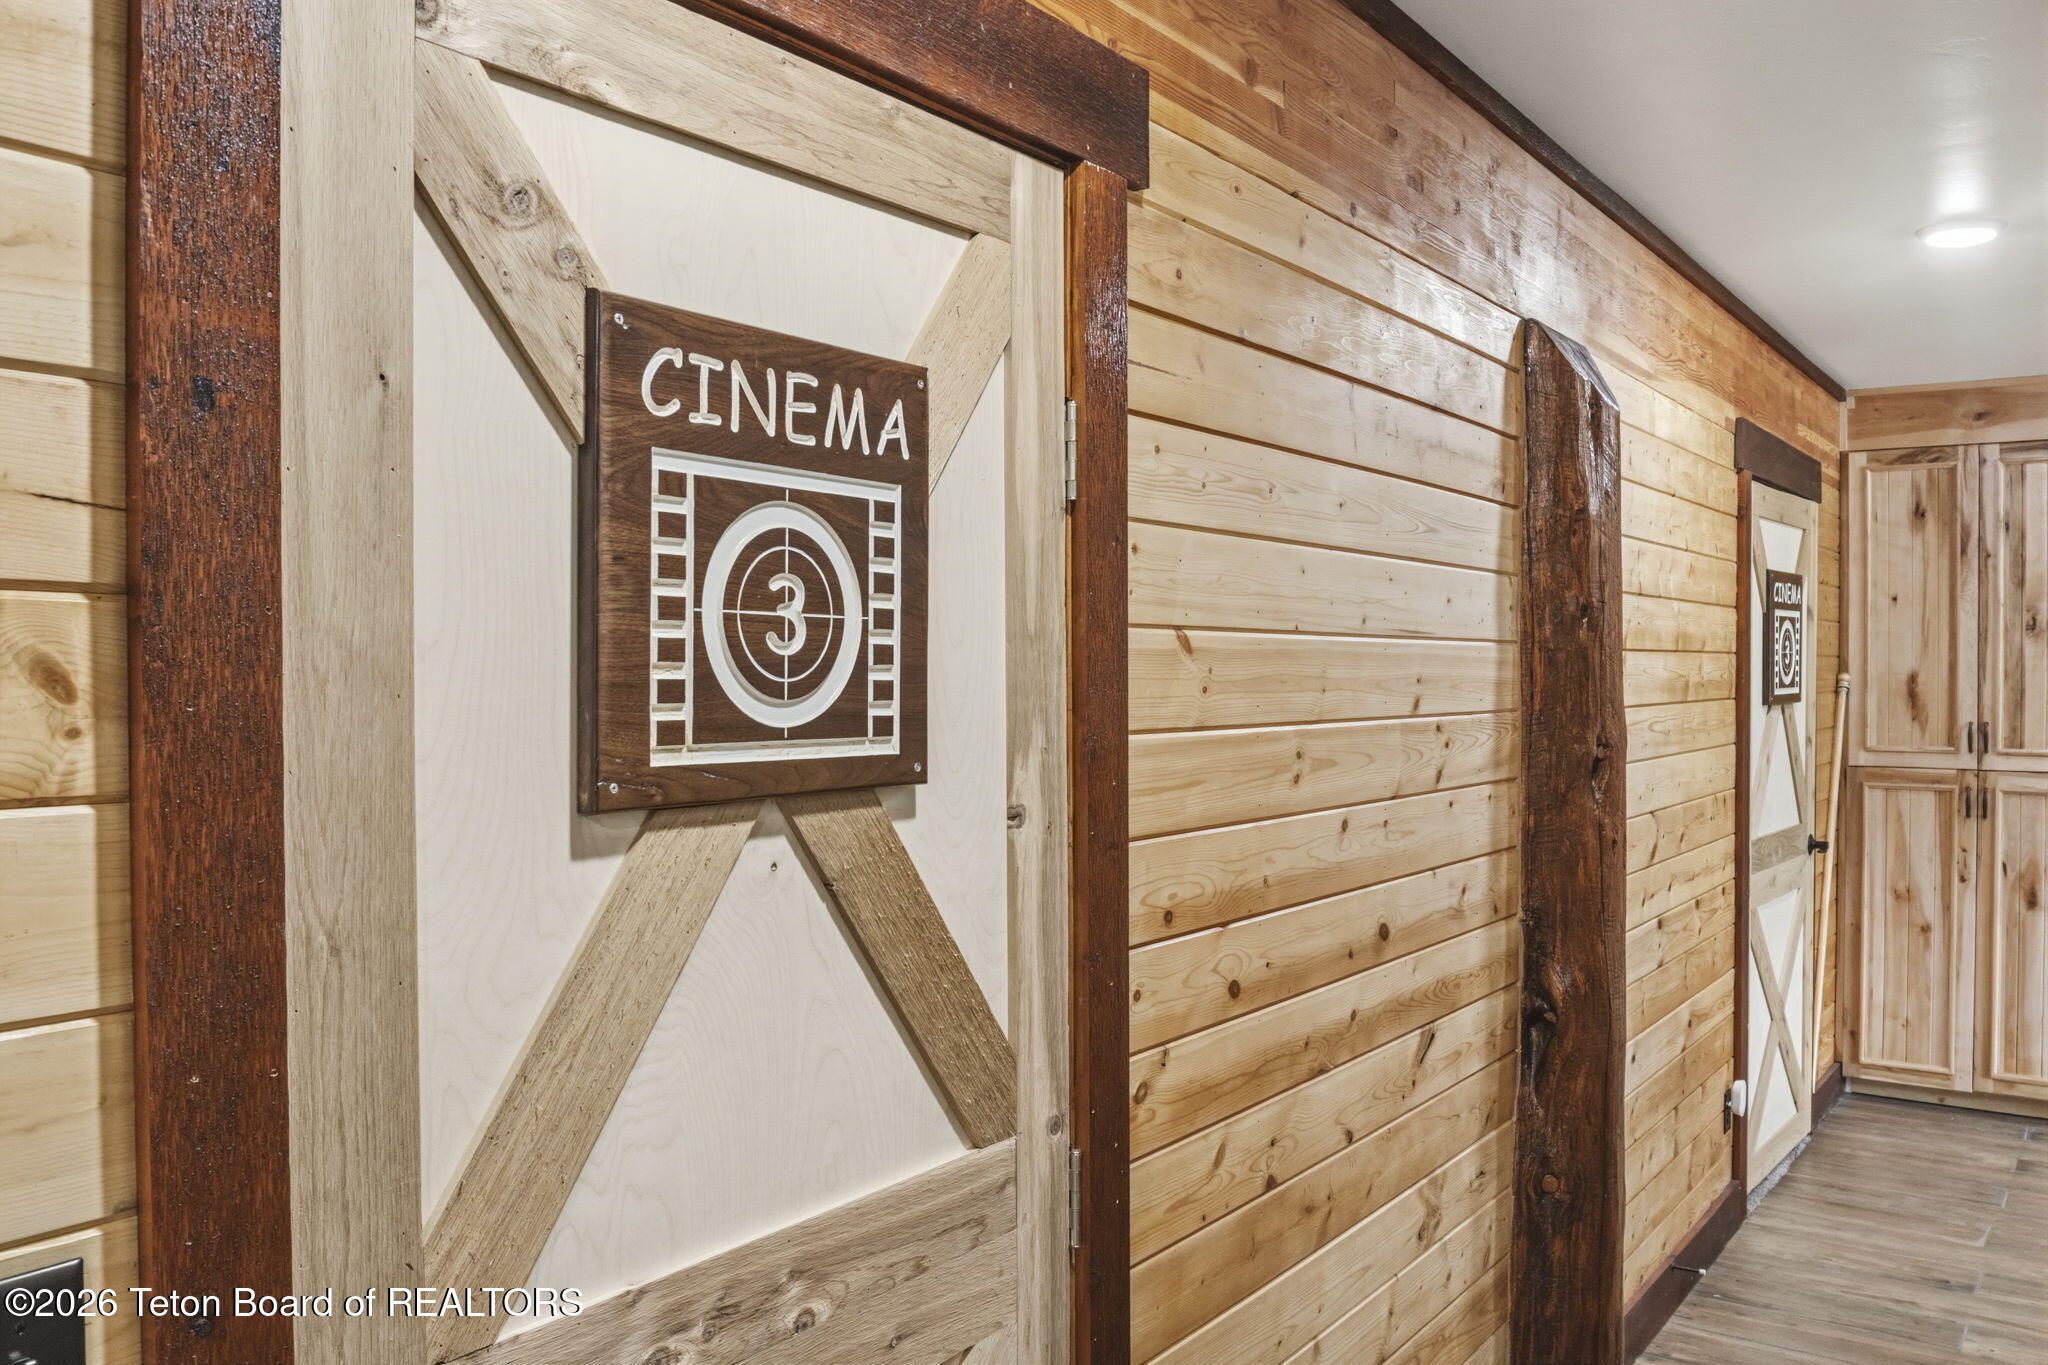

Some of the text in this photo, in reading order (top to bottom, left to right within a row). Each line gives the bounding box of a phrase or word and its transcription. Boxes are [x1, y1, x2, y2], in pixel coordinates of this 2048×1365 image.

[641, 347, 910, 460] CINEMA
[766, 573, 807, 656] 3
[1774, 582, 1802, 604] CINEMA
[1784, 640, 1790, 665] 3
